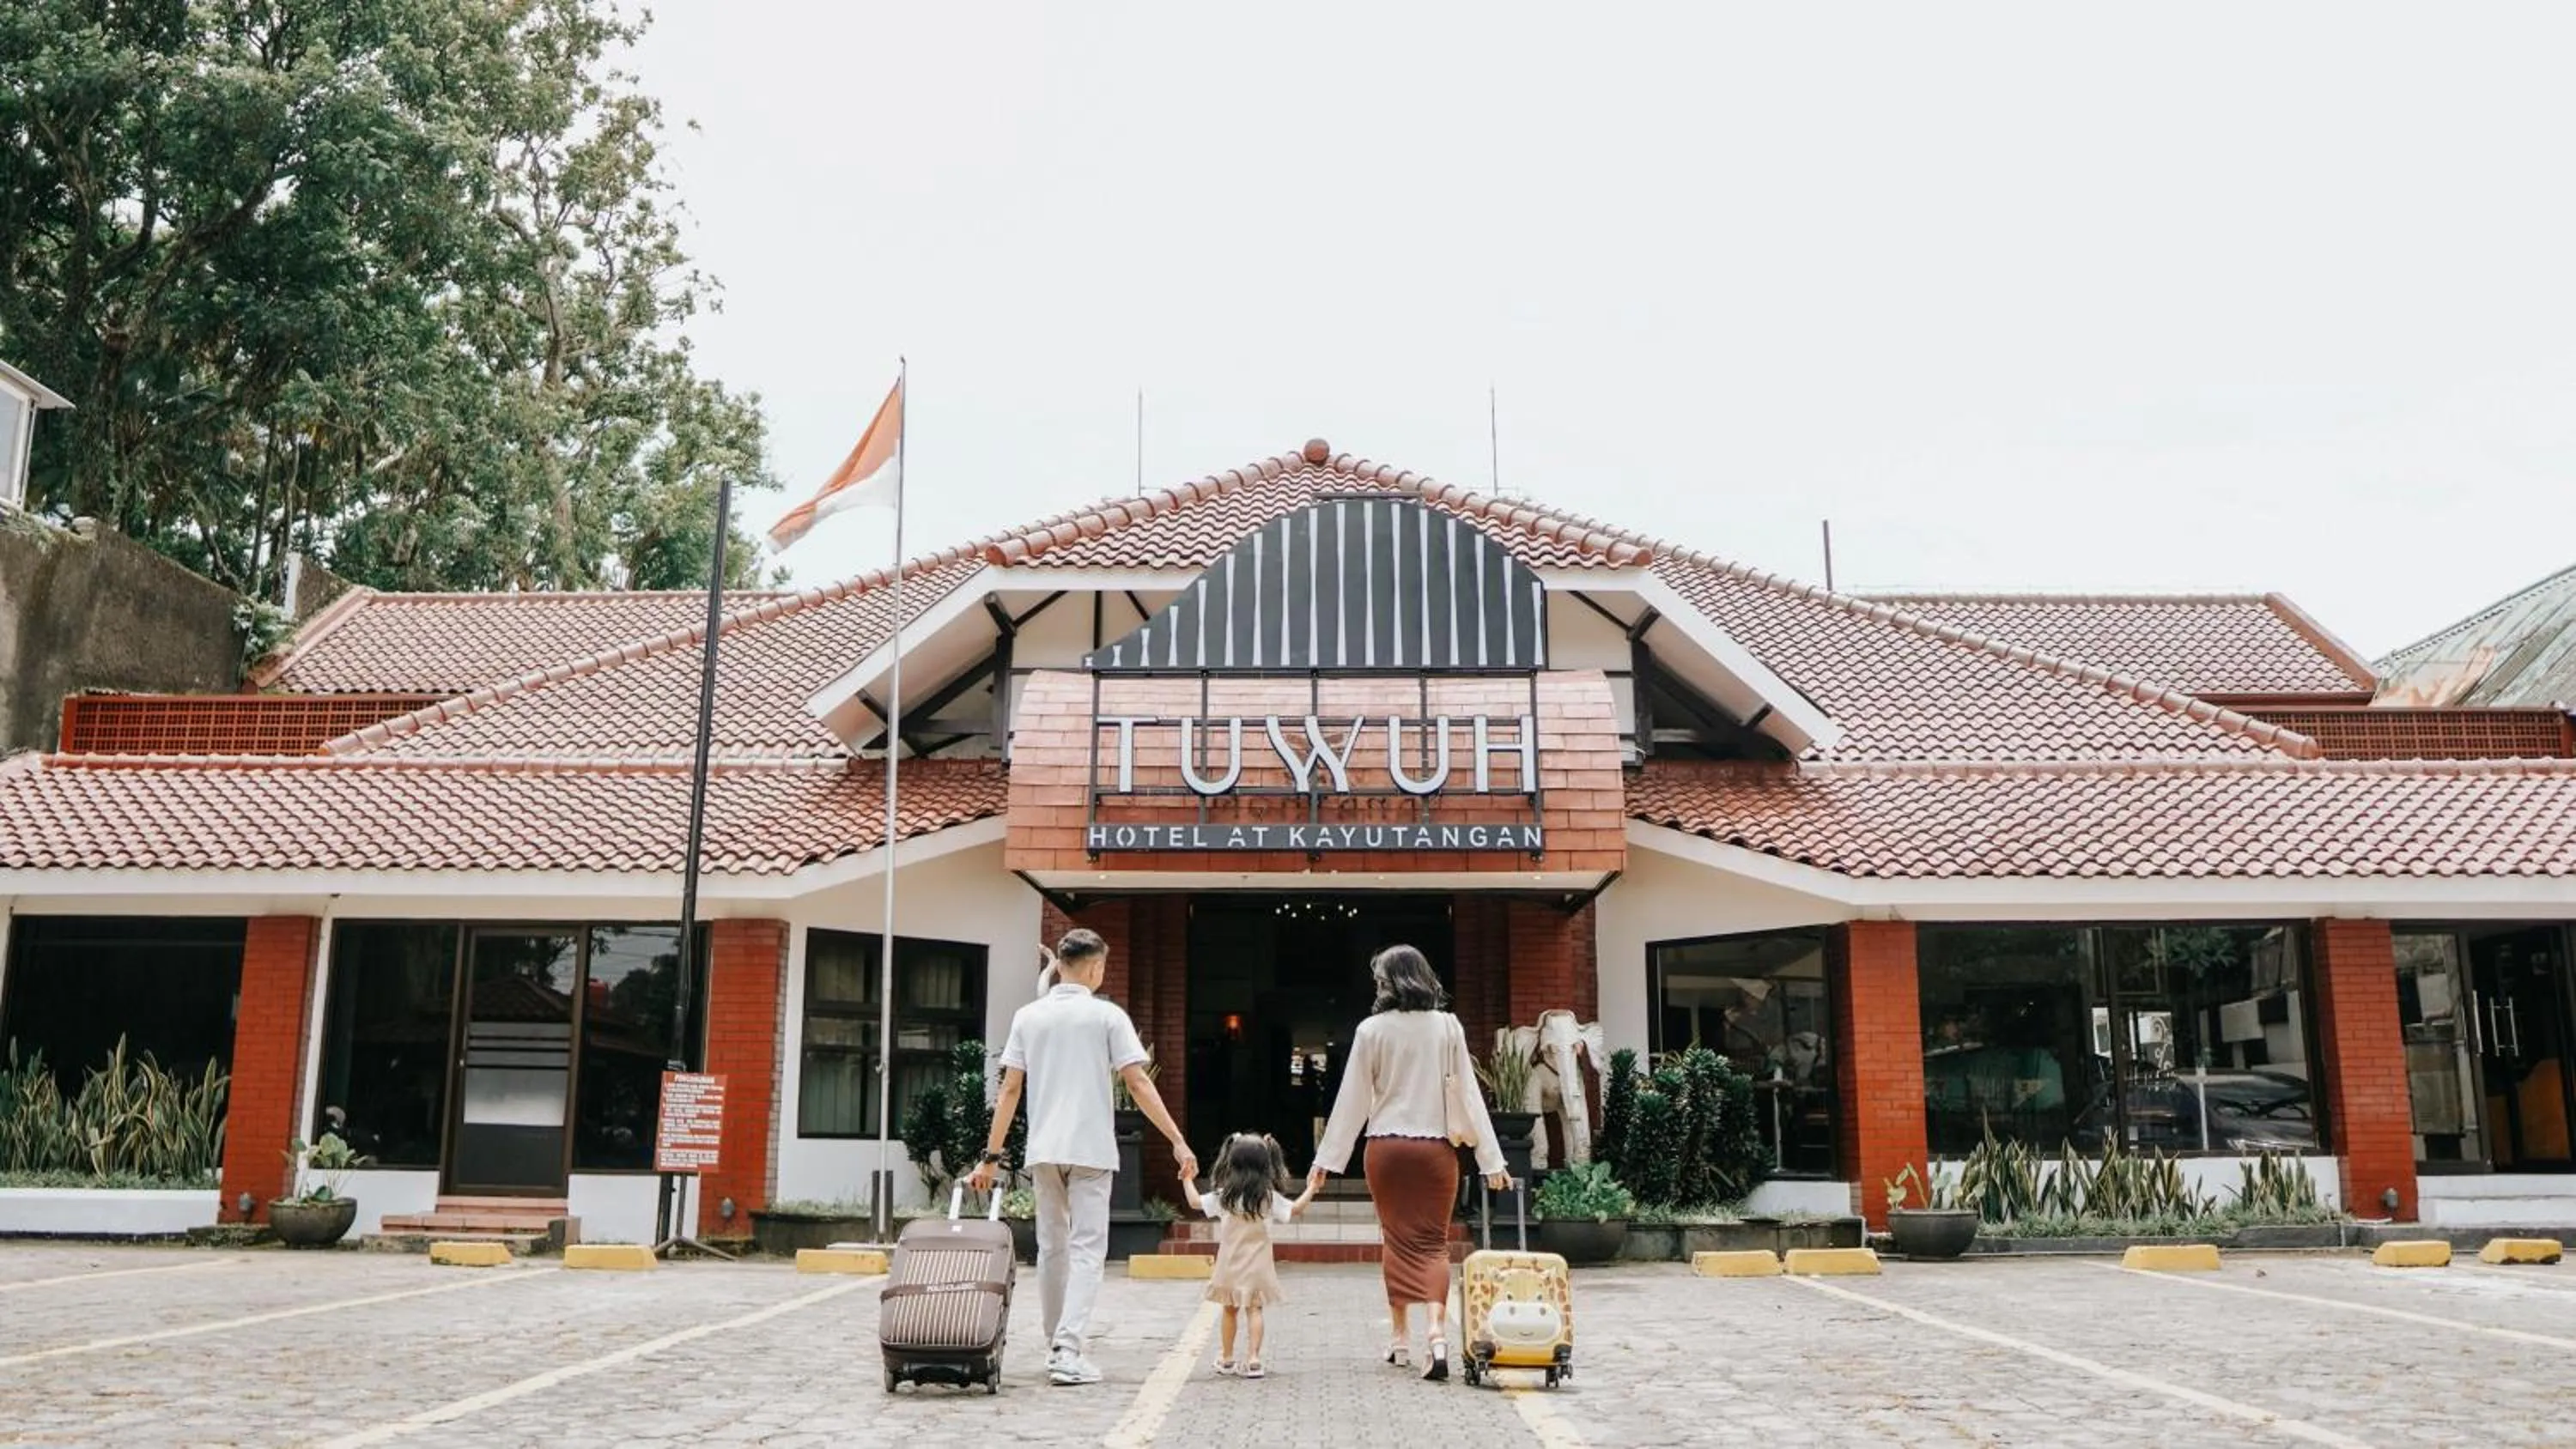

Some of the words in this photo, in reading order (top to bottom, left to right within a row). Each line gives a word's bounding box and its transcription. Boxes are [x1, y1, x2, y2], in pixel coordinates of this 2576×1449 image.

[1097, 714, 1536, 795] TUWUH
[1089, 826, 1208, 848] HOTEL
[1227, 826, 1270, 848] AT
[1289, 826, 1542, 848] KAYUTANGAN
